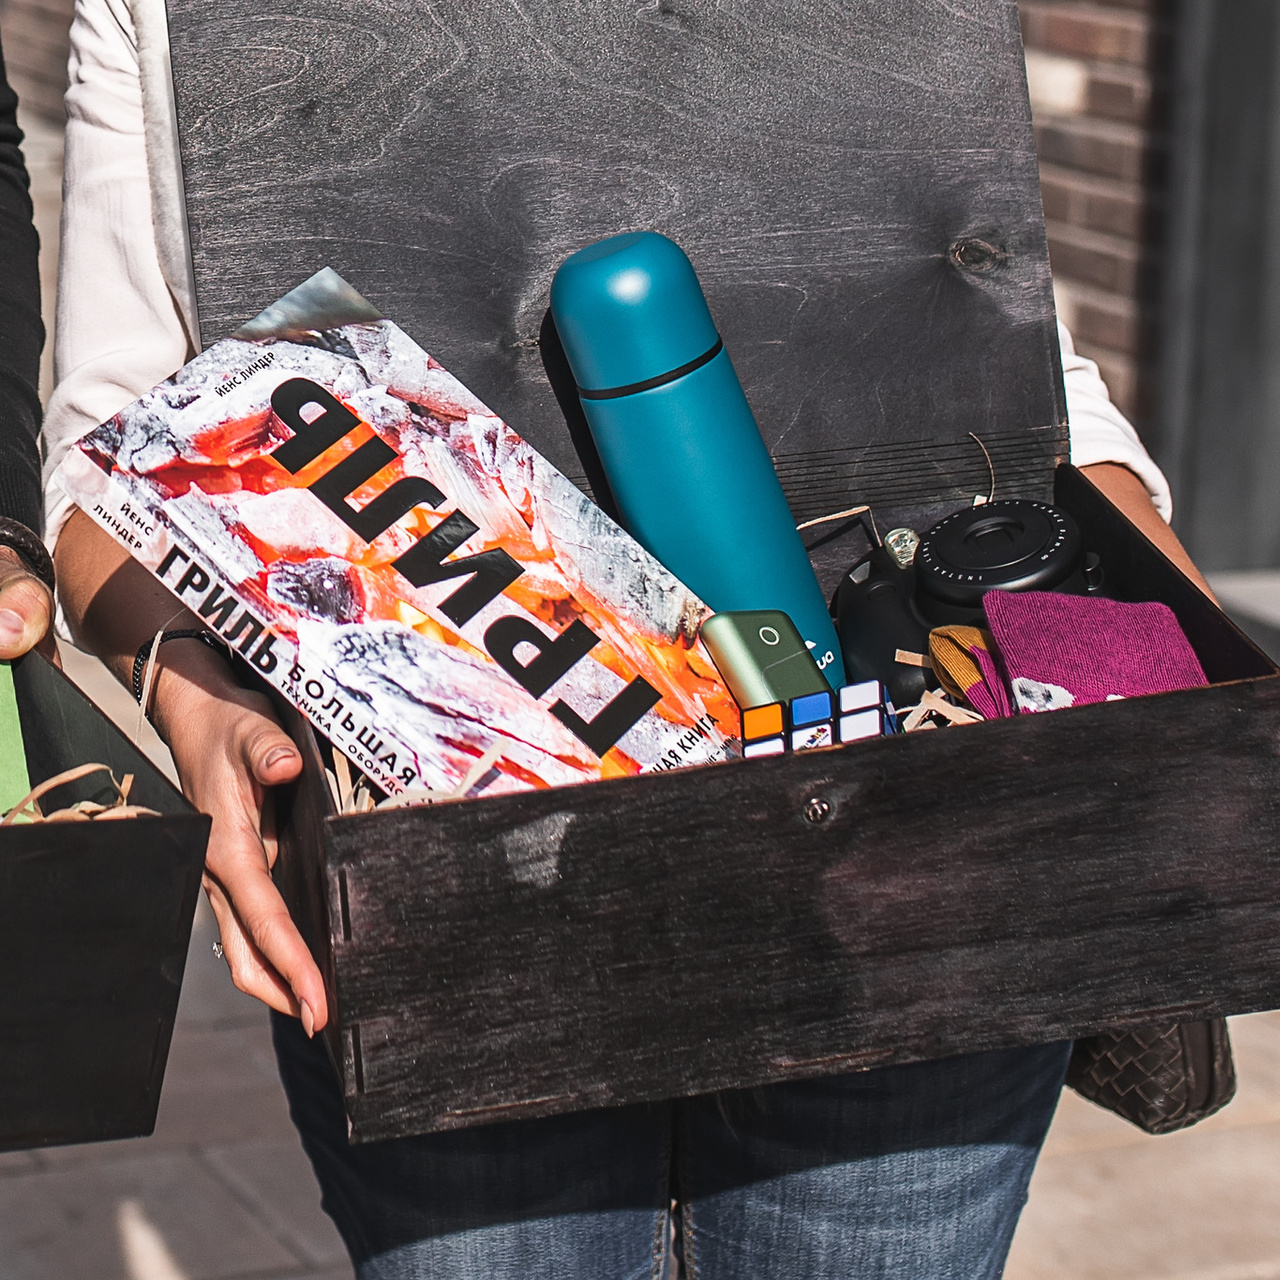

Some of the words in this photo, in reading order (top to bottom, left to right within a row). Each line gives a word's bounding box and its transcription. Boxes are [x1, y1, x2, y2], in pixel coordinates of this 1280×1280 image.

[214, 376, 242, 397] ЙЕНС
[239, 351, 275, 381] ЛИНДЕР
[93, 504, 143, 550] ЛИНДЕР
[120, 503, 154, 537] ЙЕНС
[270, 376, 663, 758] ГРИЛЬ
[155, 543, 278, 675] ГРИЛЬ
[280, 679, 333, 732] ТЕХНИКА
[288, 661, 417, 787] БОЛЬШАЯ
[677, 713, 719, 753] КНИГА
